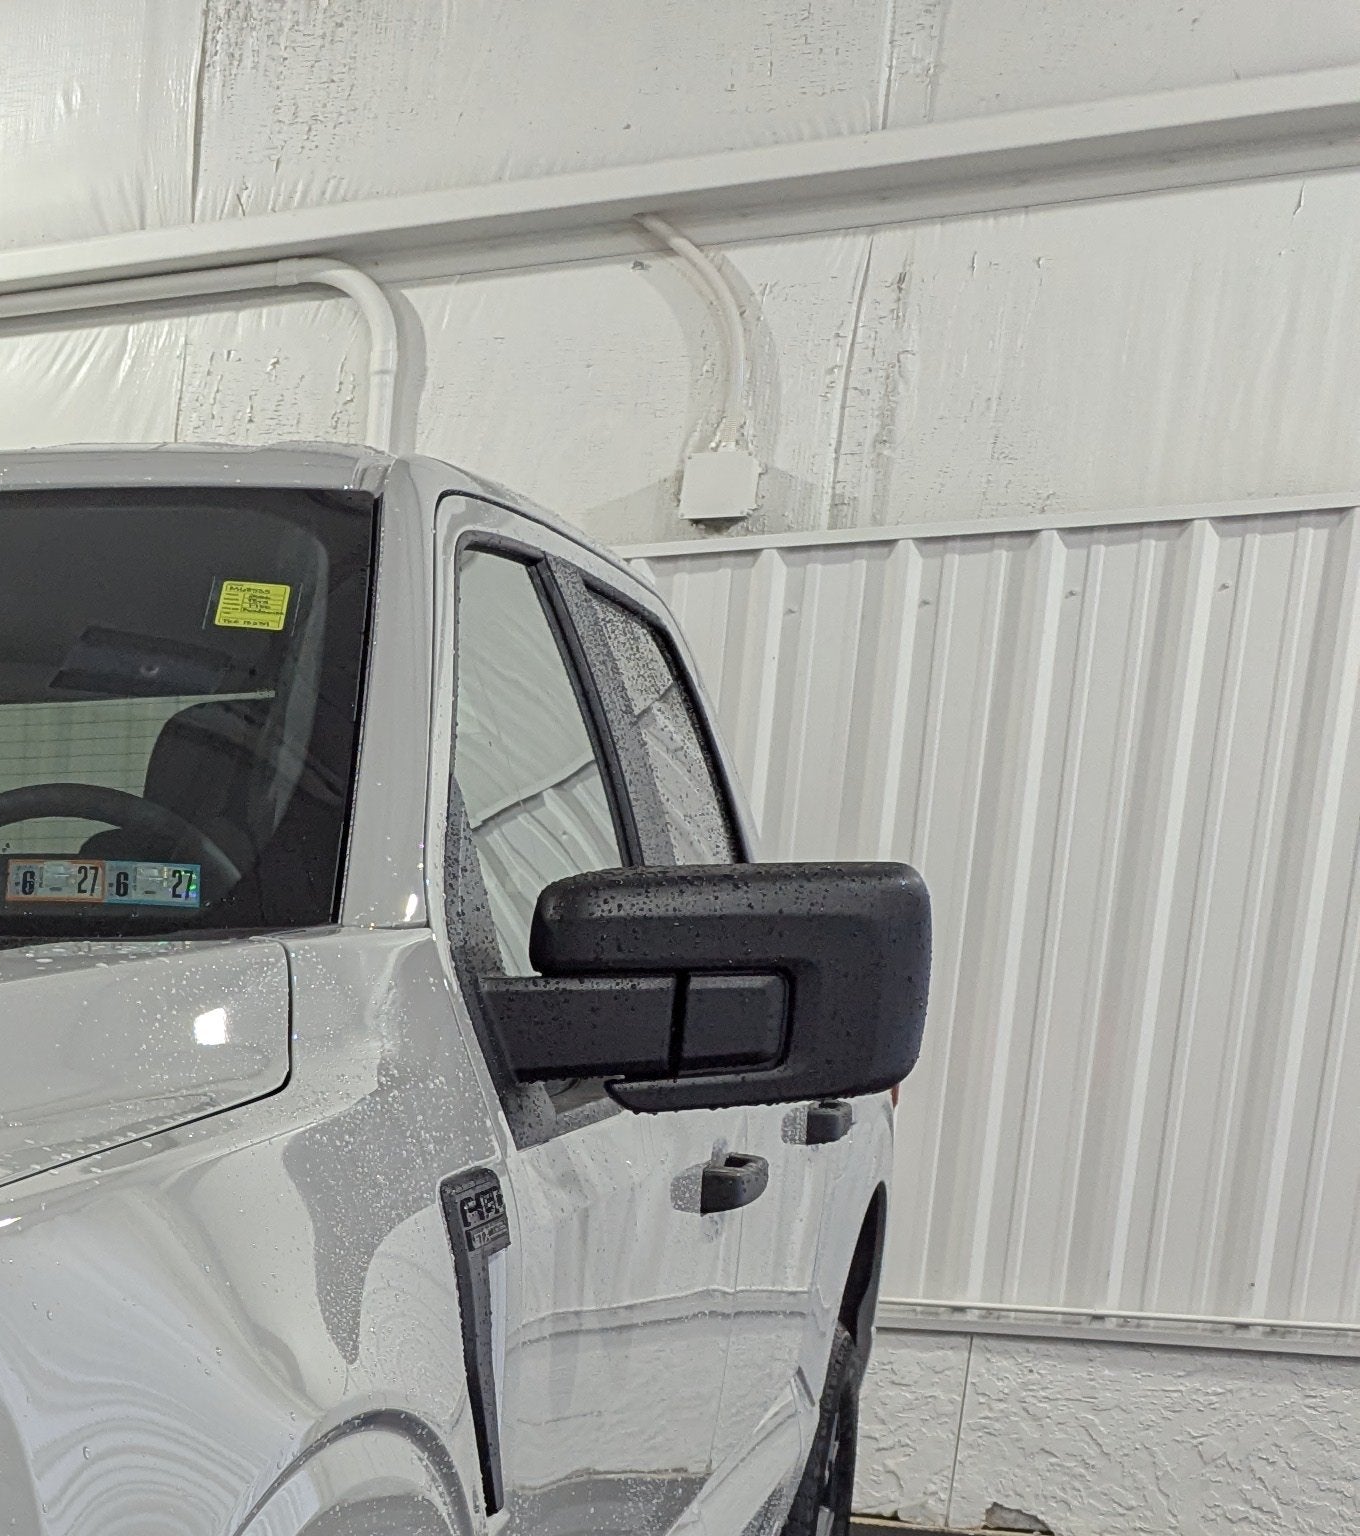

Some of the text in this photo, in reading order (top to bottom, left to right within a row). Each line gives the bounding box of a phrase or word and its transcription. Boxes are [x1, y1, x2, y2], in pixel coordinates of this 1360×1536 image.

[22, 870, 36, 896] 6
[77, 865, 99, 897] 27
[115, 871, 129, 897] 6
[171, 869, 194, 900] 27
